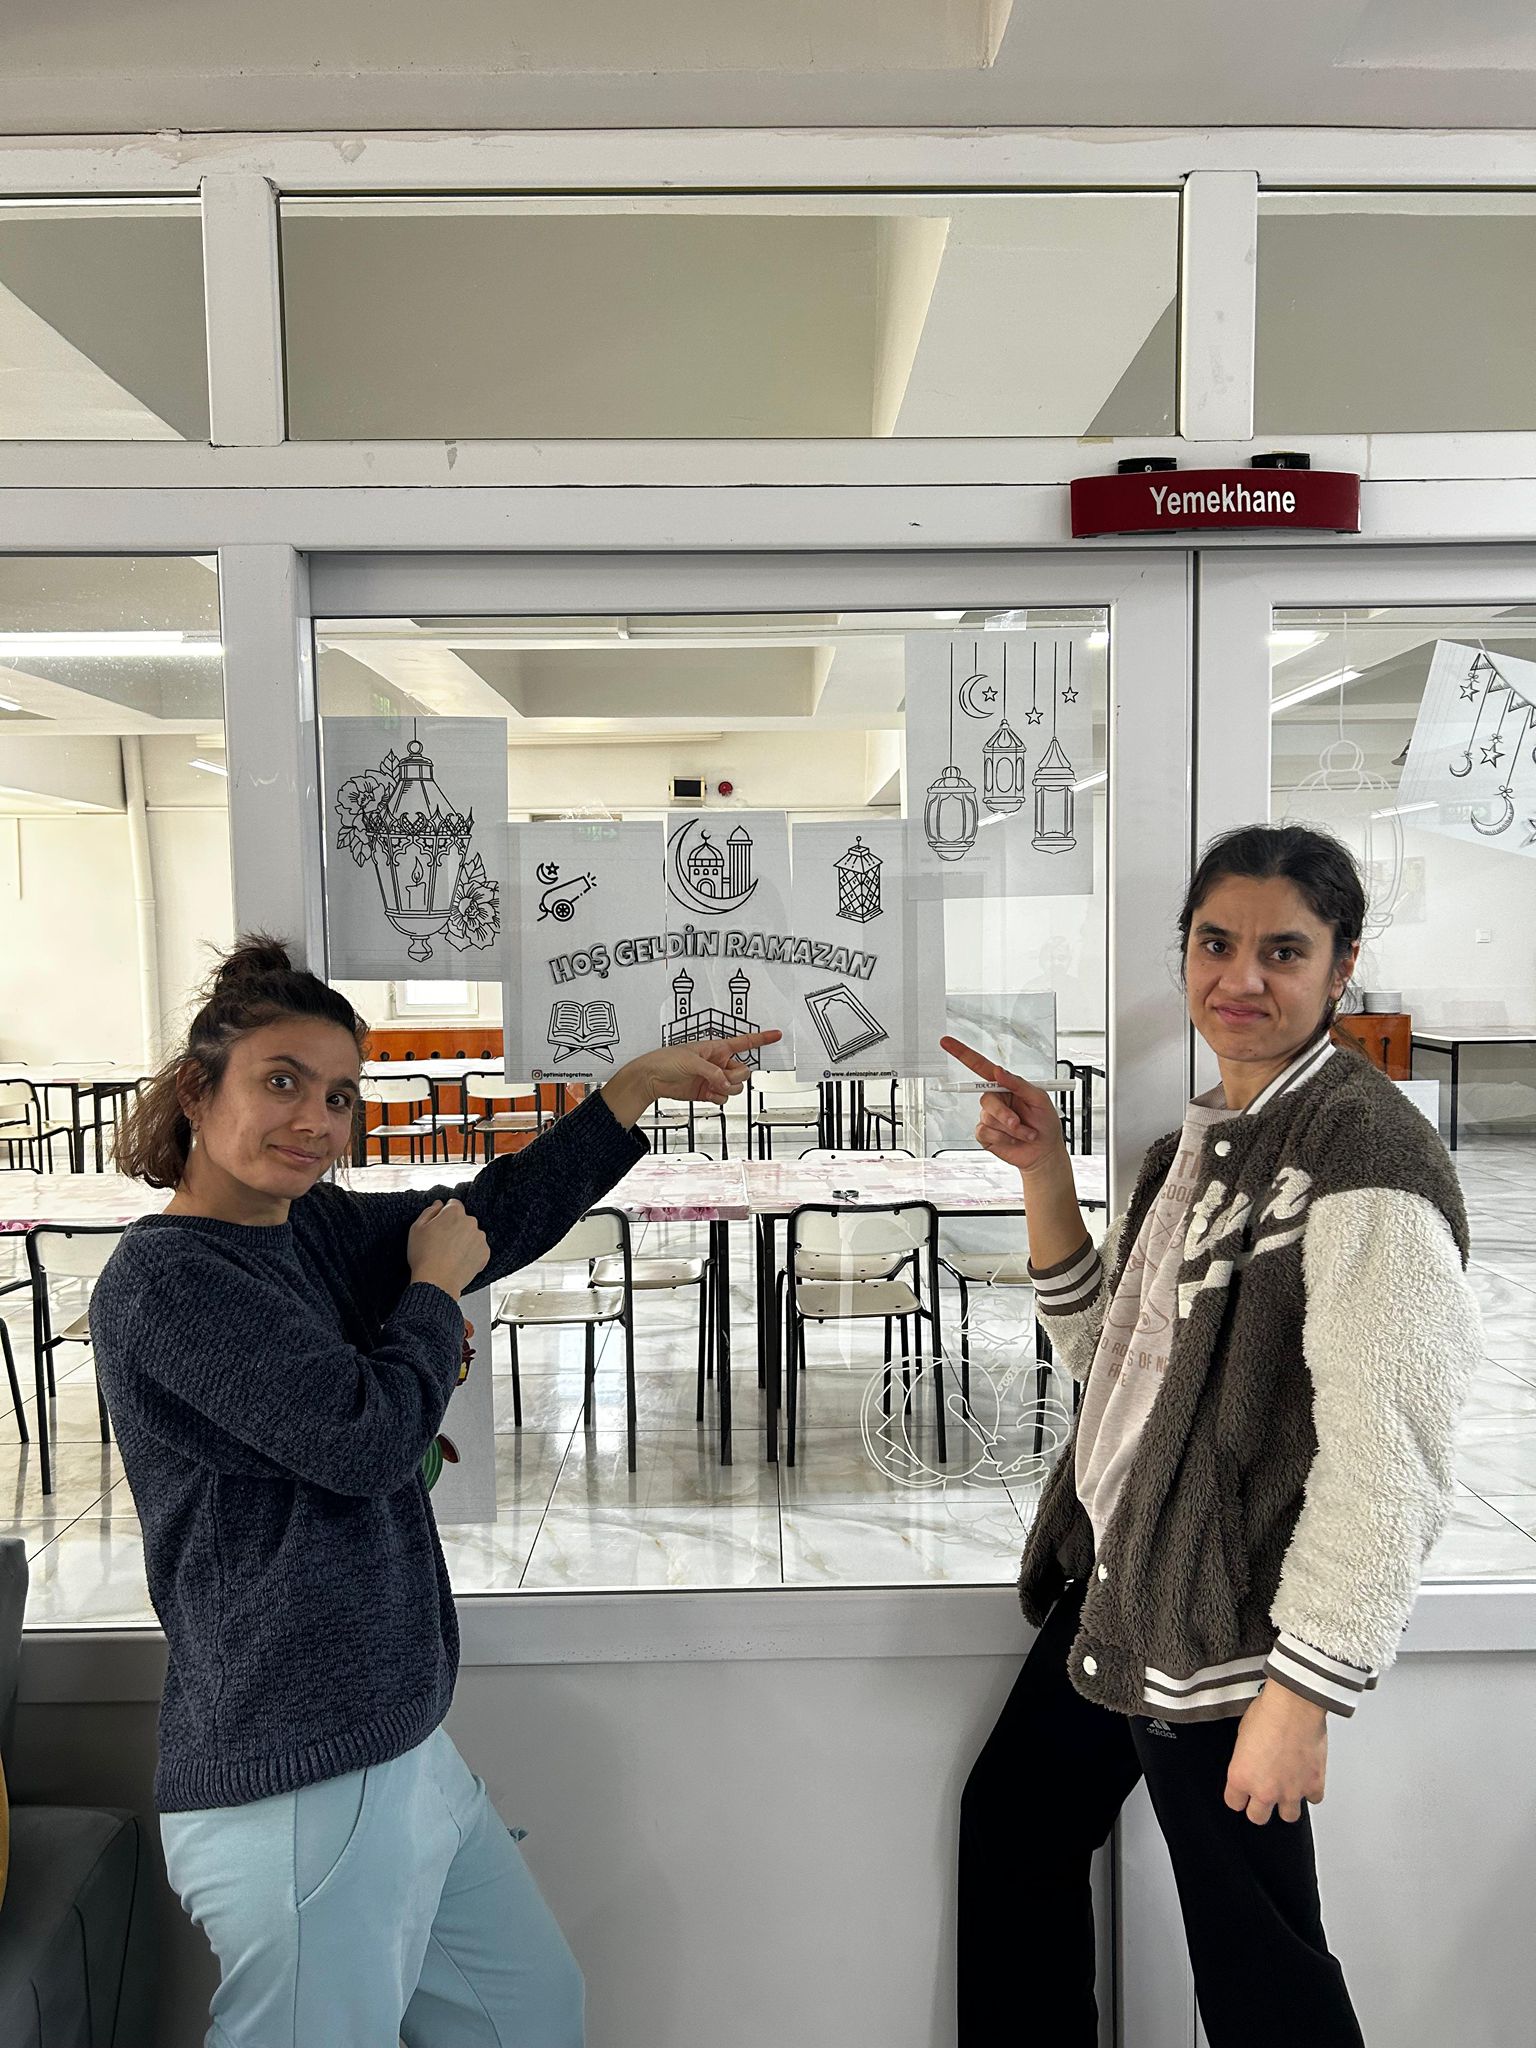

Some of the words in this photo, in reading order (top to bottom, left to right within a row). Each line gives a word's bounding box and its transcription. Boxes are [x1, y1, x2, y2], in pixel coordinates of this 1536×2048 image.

[1149, 483, 1296, 515] Yemekhane
[549, 942, 611, 984] HOŞ
[614, 923, 720, 967] GELDİN
[725, 930, 878, 981] RAMAZAN
[1138, 1351, 1153, 1370] OF
[1146, 1727, 1178, 1739] adidas
